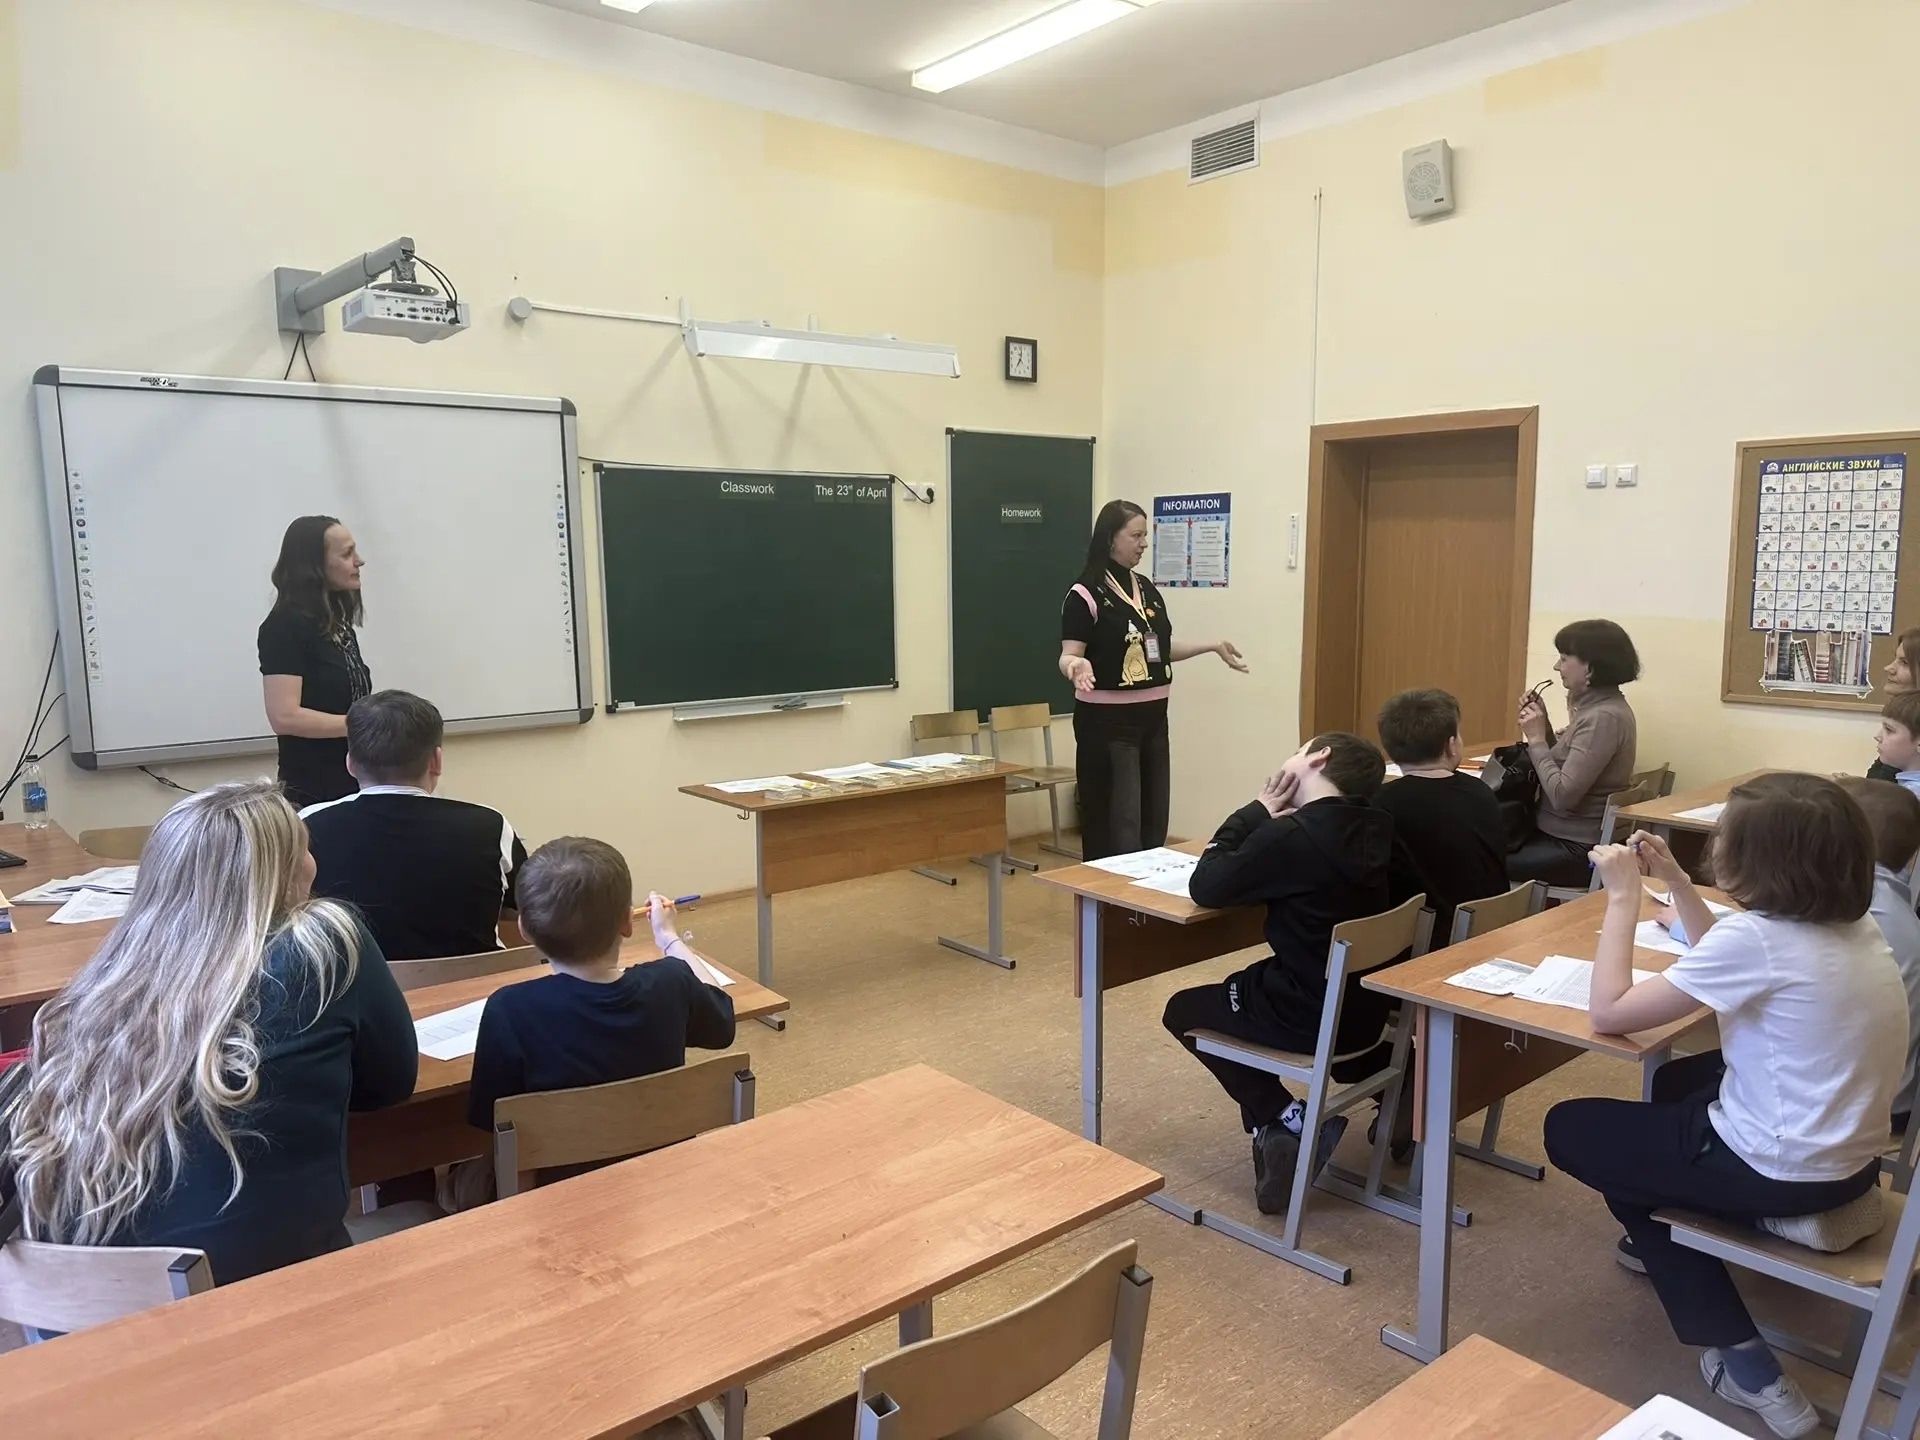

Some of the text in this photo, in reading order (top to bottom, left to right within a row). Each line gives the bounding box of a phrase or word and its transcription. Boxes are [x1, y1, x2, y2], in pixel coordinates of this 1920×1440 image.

[1782, 460, 1845, 473] АНГЛИЙСКИЕ
[1847, 459, 1880, 469] ЗВУКИ
[720, 480, 775, 495] Classwork
[815, 484, 833, 496] The
[856, 486, 866, 497] of
[867, 486, 887, 499] April
[1001, 507, 1041, 517] Homework
[1162, 499, 1220, 511] INFORMATION
[1229, 982, 1240, 1012] FILA
[1281, 1108, 1301, 1124] ILA
